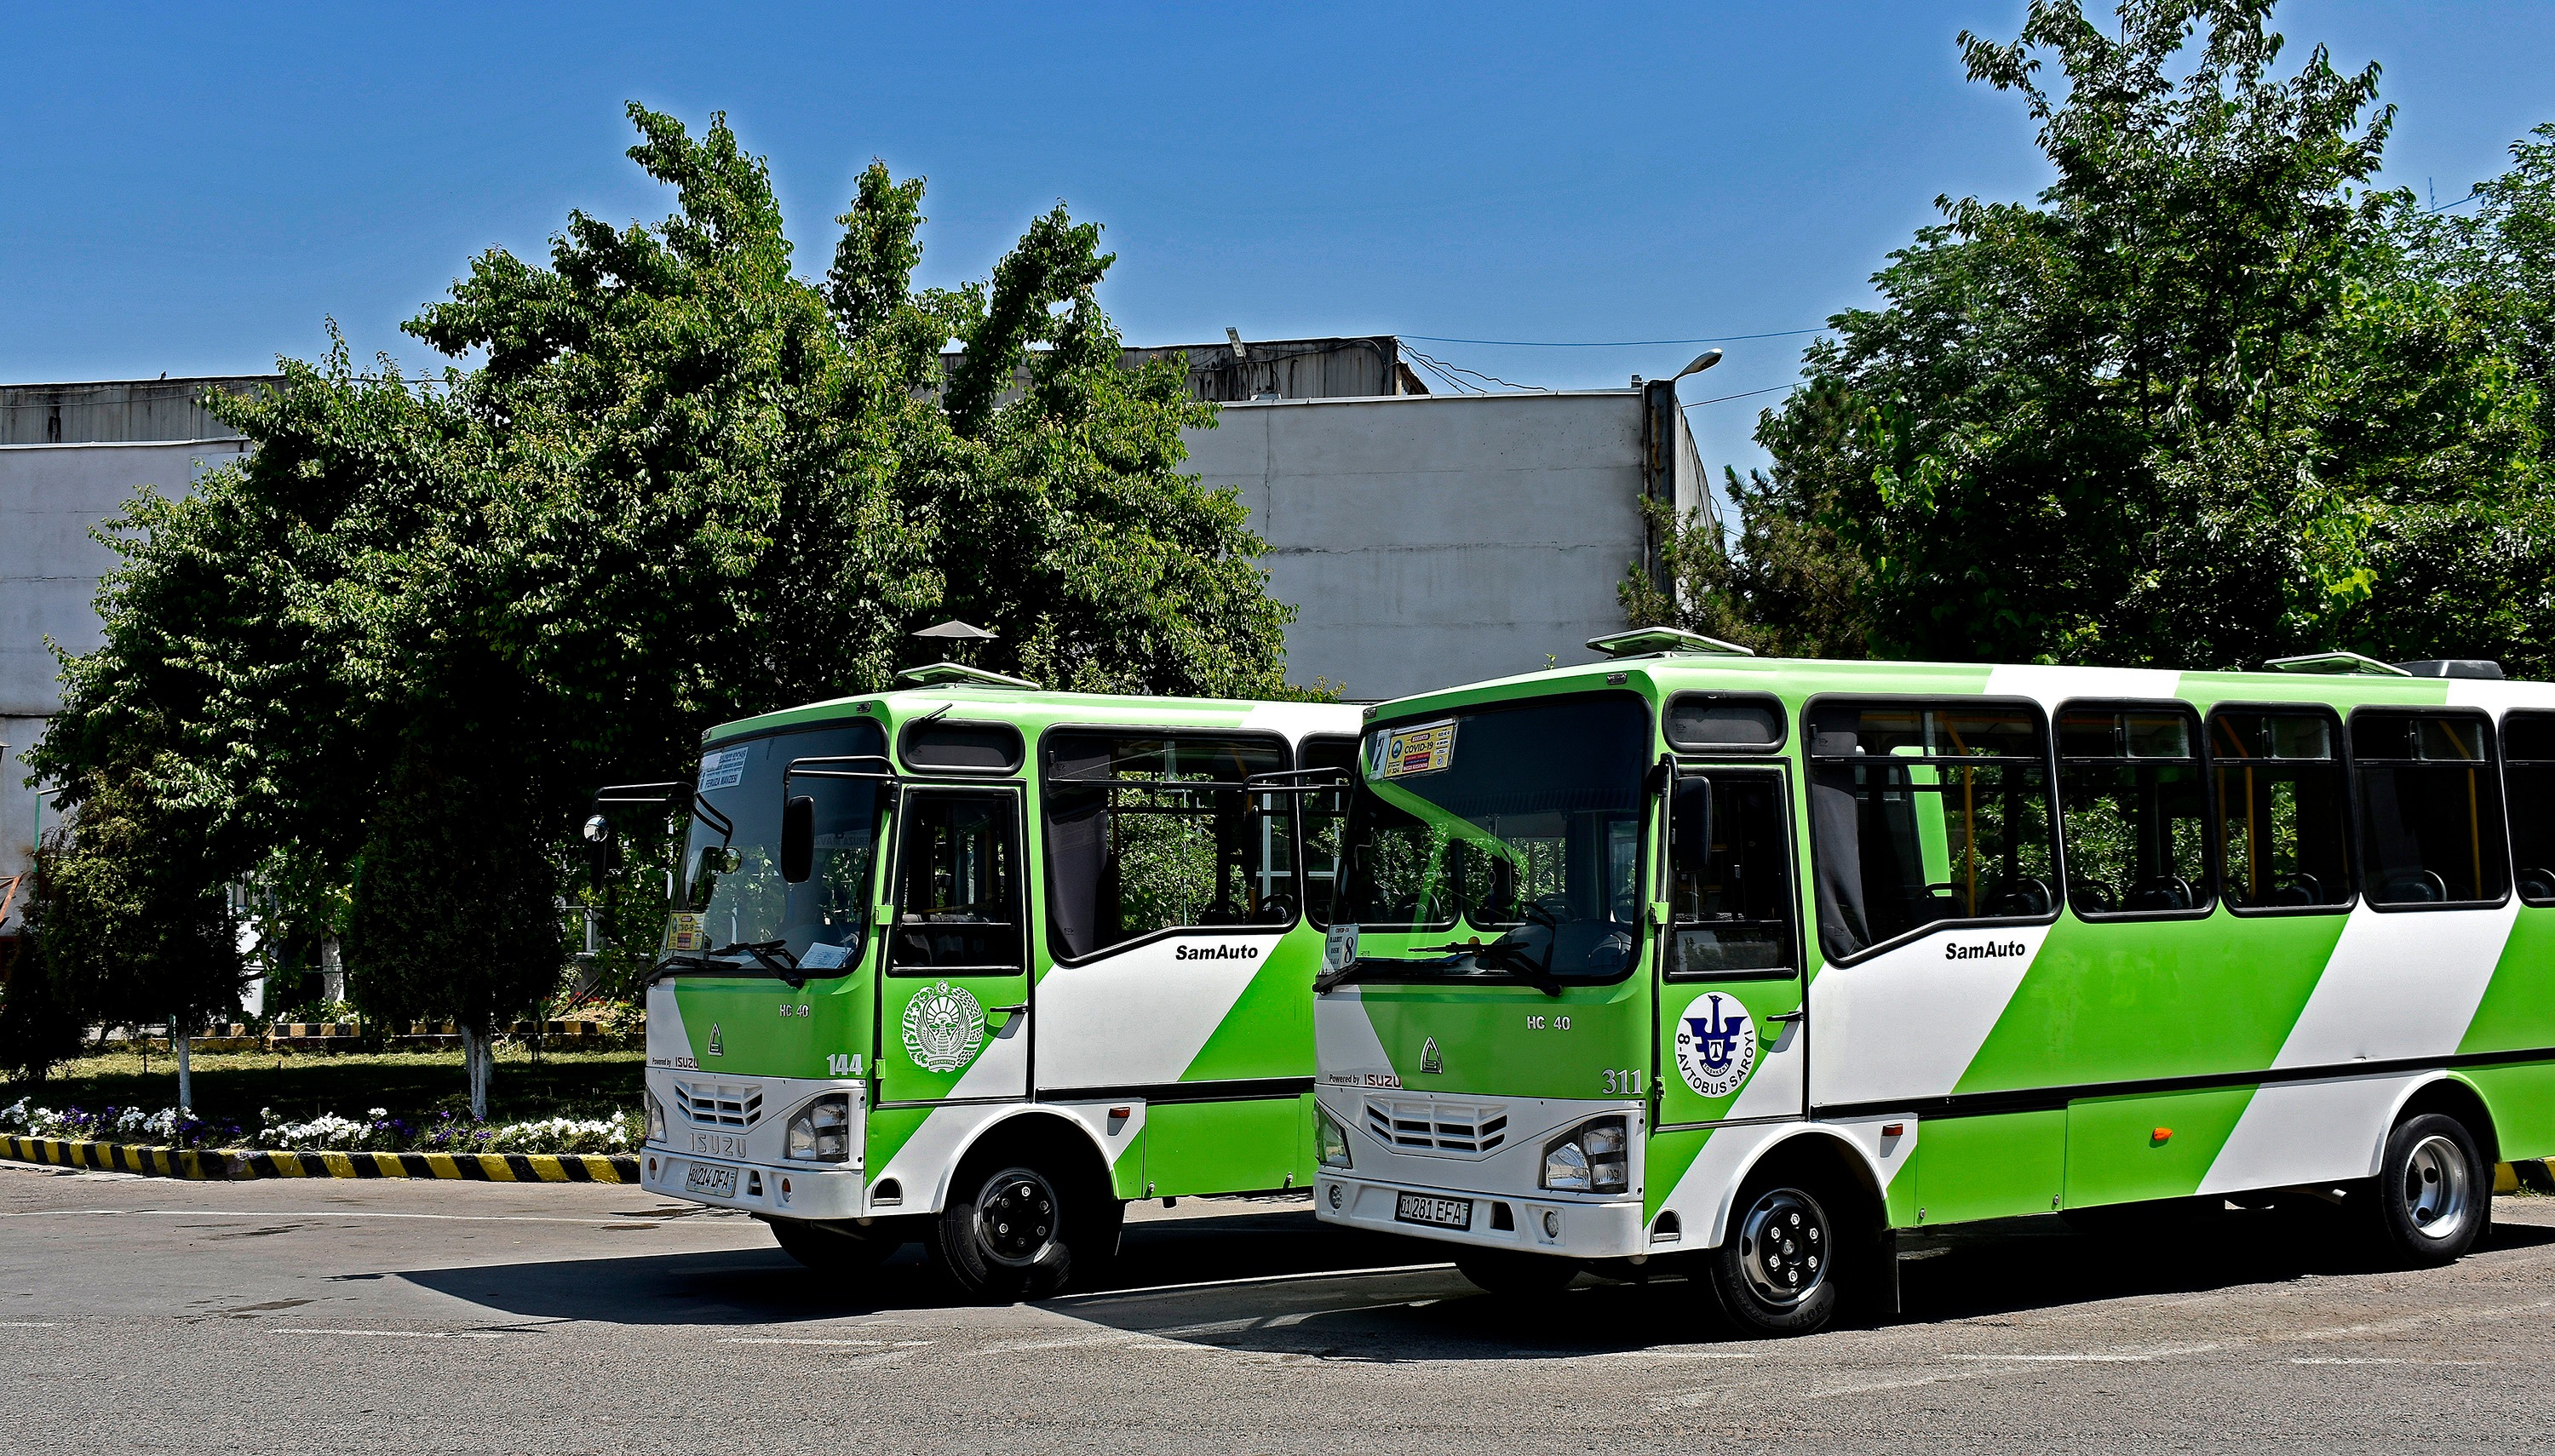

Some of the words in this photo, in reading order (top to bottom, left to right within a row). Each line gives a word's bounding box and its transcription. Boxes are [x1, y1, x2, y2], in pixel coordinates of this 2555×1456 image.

[1404, 742, 1434, 754] COVID-19
[1175, 943, 1259, 960] SamAuto
[1344, 936, 1354, 964] 8
[1944, 940, 2026, 960] SamAuto
[779, 1004, 792, 1017] HC
[796, 1004, 810, 1017] 40
[1526, 1015, 1546, 1030] HC
[1553, 1016, 1571, 1031] 40
[675, 1056, 698, 1069] ISUZU
[826, 1053, 864, 1076] 144
[1677, 1033, 1727, 1095] 8-AVTOBUS
[1729, 1029, 1754, 1087] SAROYI
[1329, 1073, 1352, 1083] Powered
[1352, 1074, 1360, 1086] by
[1364, 1073, 1402, 1088] ISUZU
[1601, 1069, 1644, 1095] 311
[690, 1132, 747, 1159] ISUZU
[697, 1167, 713, 1187] 214
[711, 1169, 730, 1190] DFA
[1400, 1198, 1410, 1215] 01
[1411, 1197, 1433, 1220] 281
[1435, 1200, 1461, 1224] EFA
